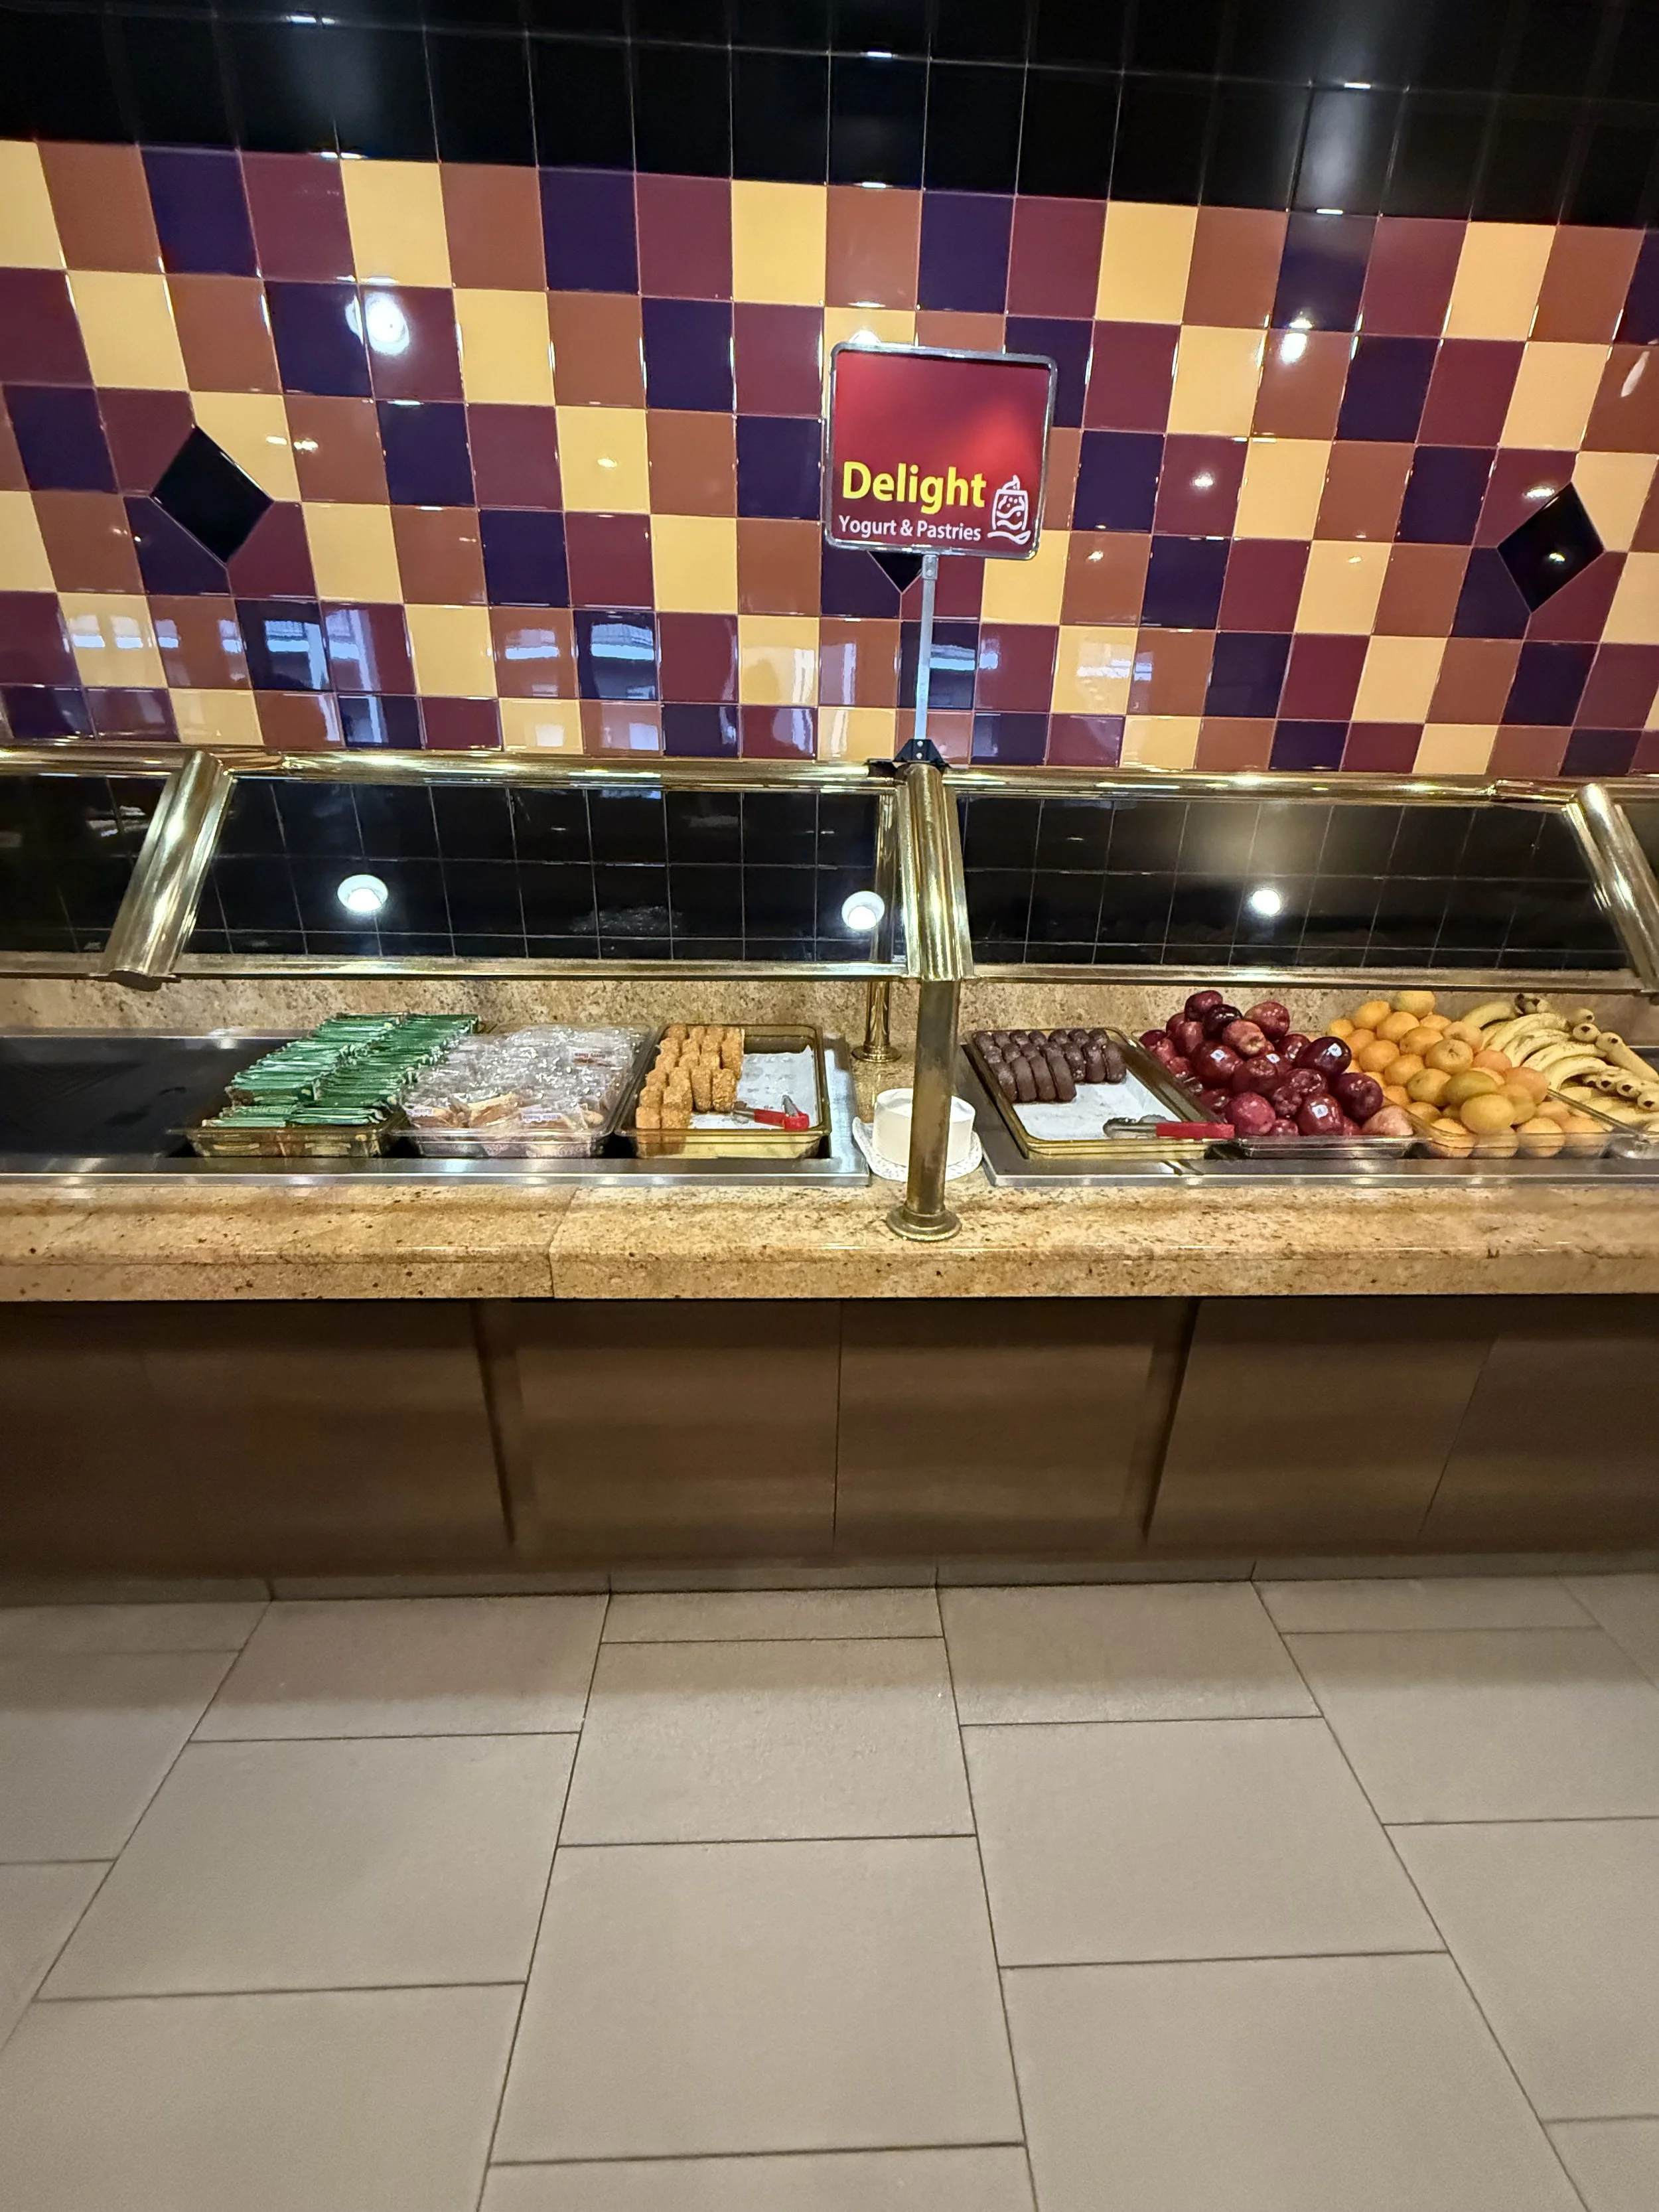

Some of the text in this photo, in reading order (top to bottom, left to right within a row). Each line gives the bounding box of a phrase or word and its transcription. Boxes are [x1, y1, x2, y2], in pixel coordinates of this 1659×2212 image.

[843, 461, 987, 514] Delight
[839, 515, 981, 541] Yogurt & Pastries
